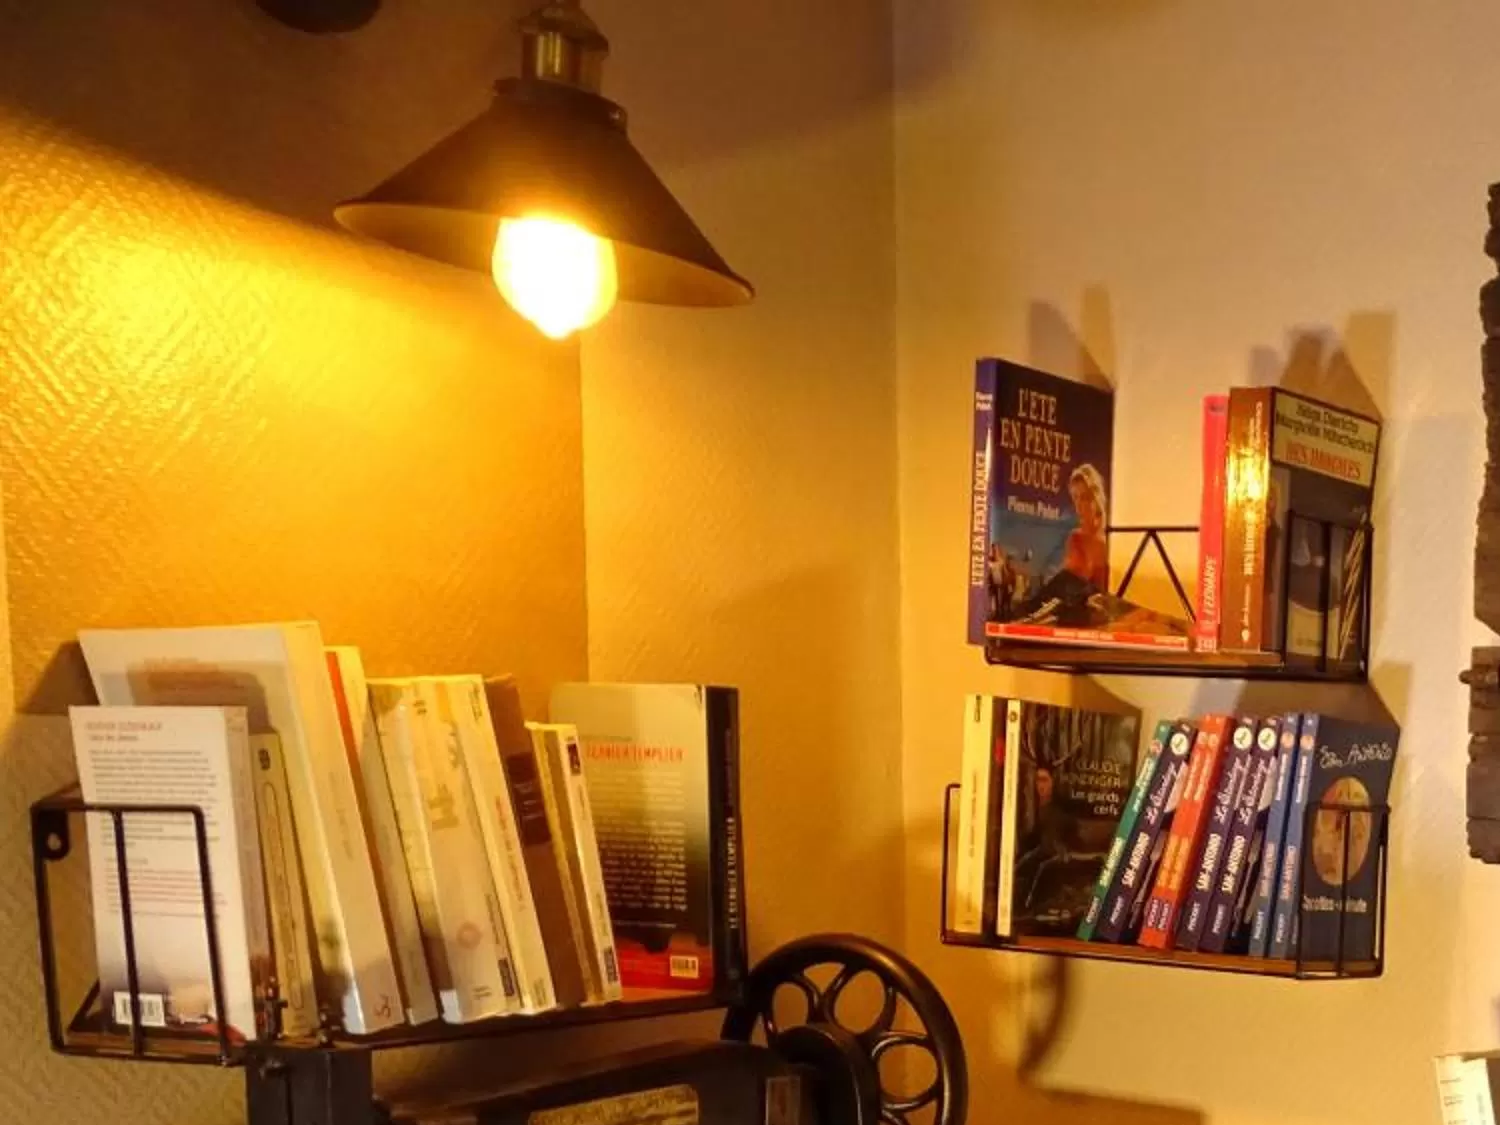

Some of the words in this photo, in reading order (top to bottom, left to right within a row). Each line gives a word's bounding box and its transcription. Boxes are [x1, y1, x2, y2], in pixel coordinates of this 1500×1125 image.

[1000, 418, 1021, 449] EN
[1025, 424, 1071, 463] PENTE
[1010, 454, 1061, 493] DOUCE
